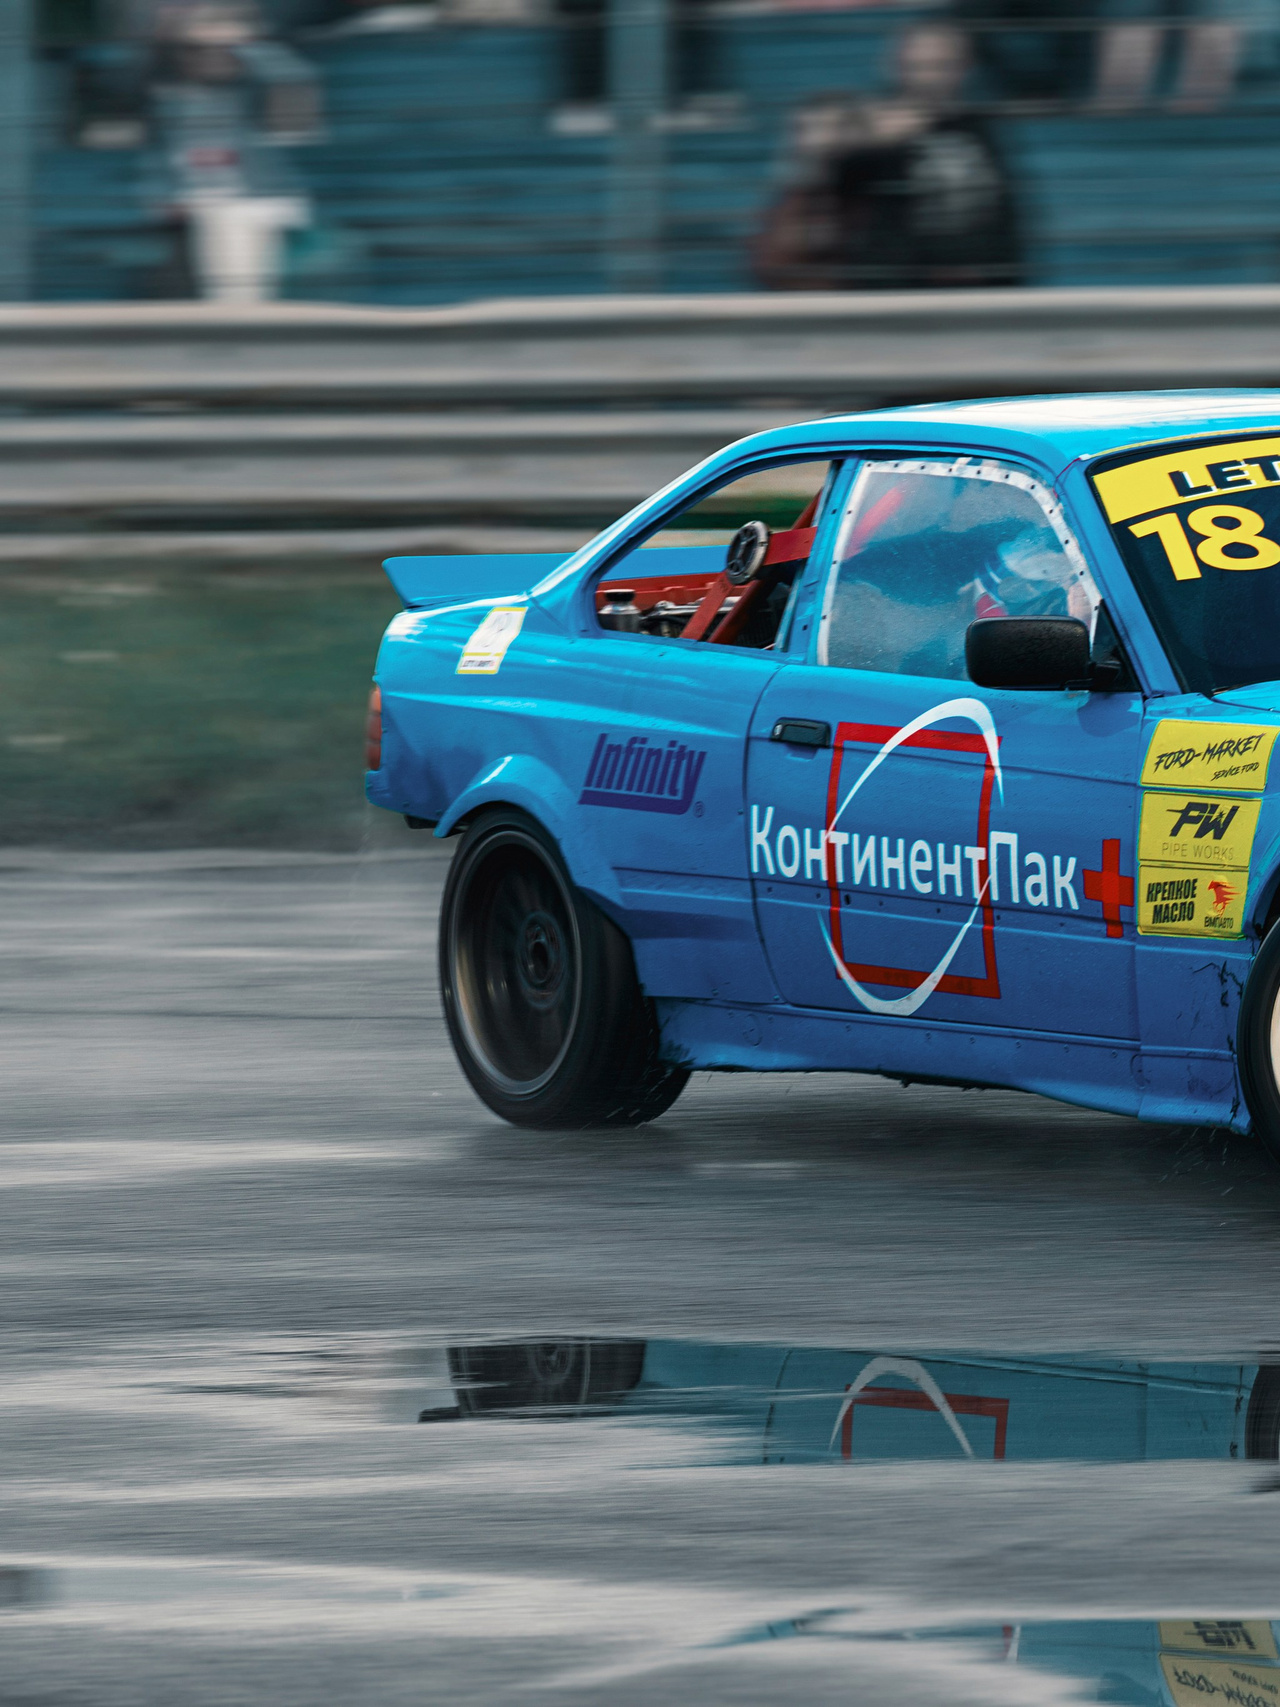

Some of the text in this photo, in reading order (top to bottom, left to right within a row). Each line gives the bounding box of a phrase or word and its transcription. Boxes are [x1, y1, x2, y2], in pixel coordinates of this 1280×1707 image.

[1154, 733, 1266, 773] FORD-MARKET
[578, 733, 707, 815] Infinity
[1166, 802, 1240, 840] PW
[751, 804, 1079, 910] КонтинентПак
[1161, 843, 1234, 860] PIPE WORKS
[1146, 878, 1198, 902] КРЕПКОЕ
[1152, 901, 1195, 924] МАСЛО
